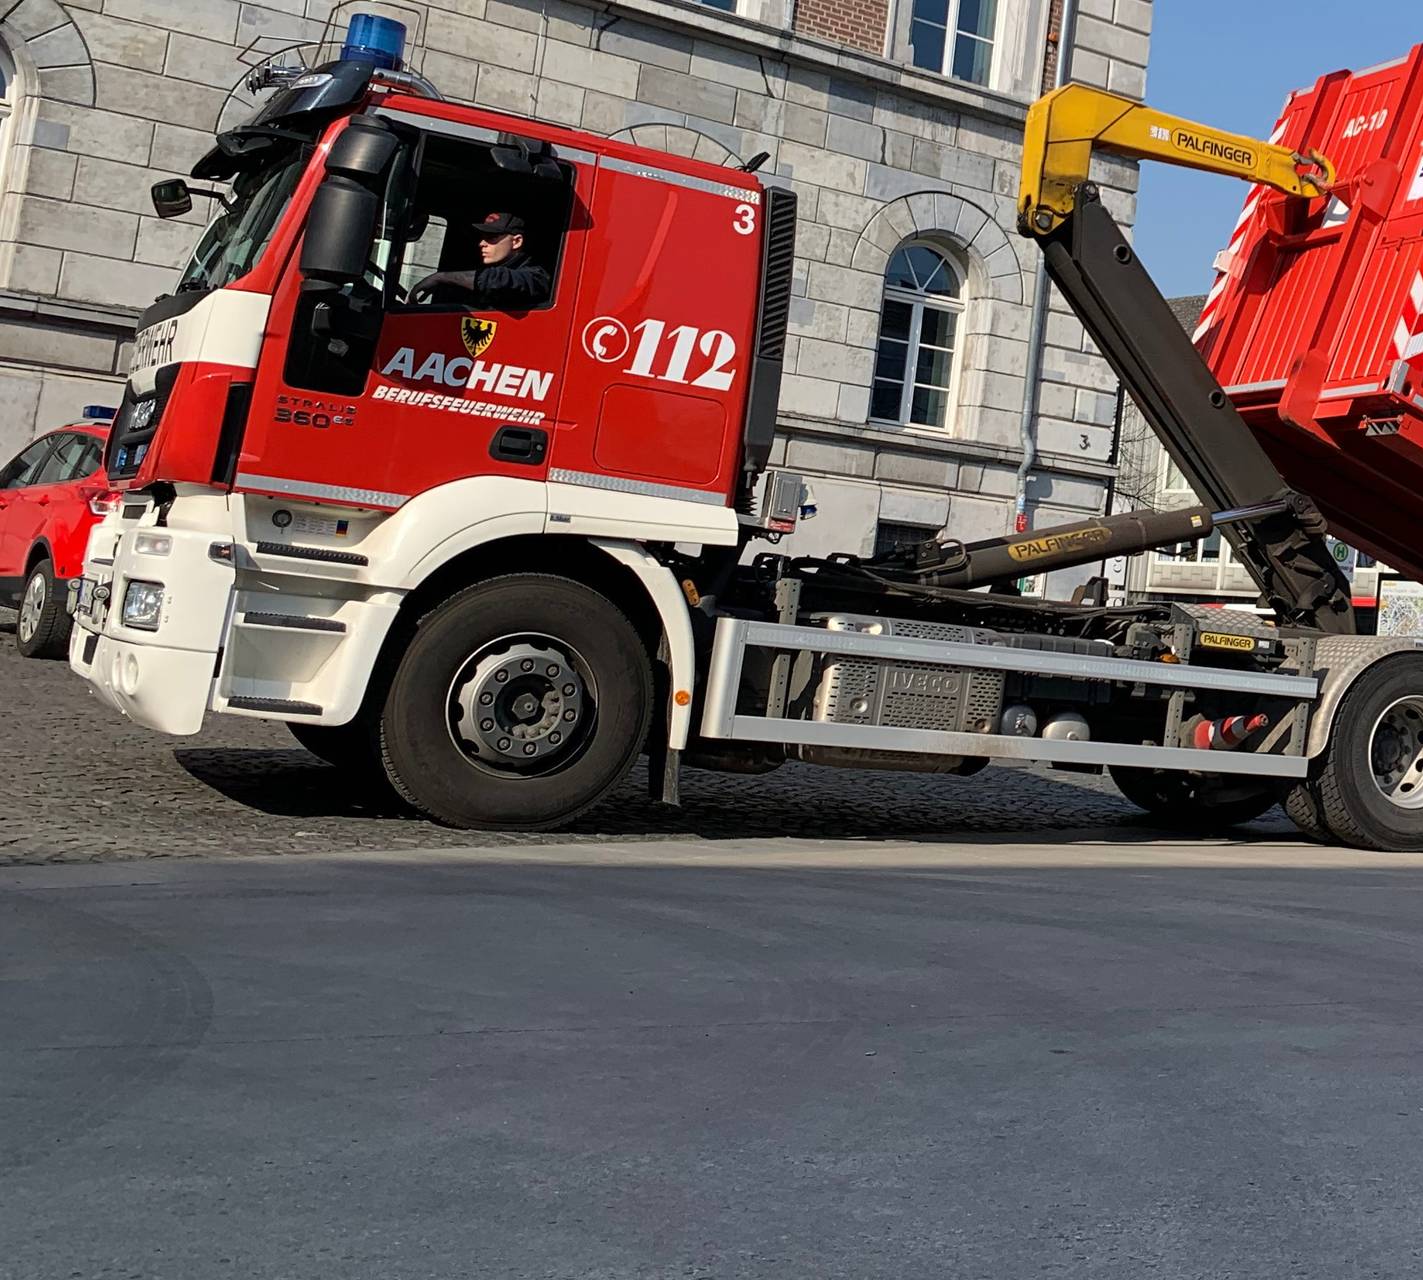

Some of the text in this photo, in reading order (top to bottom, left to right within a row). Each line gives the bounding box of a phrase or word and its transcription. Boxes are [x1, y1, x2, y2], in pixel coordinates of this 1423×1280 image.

[1342, 108, 1388, 139] AC-10
[1177, 132, 1252, 166] PALFINGER
[732, 204, 755, 235] 3
[622, 318, 737, 392] 112
[380, 347, 554, 401] AACHEN
[274, 407, 330, 429] 360
[278, 394, 357, 414] STRALIS
[372, 384, 546, 426] BERUFSFEUERWEHR
[1014, 530, 1105, 559] PALFINGER
[1203, 634, 1252, 648] PALFINGER
[891, 672, 960, 694] IVECO
